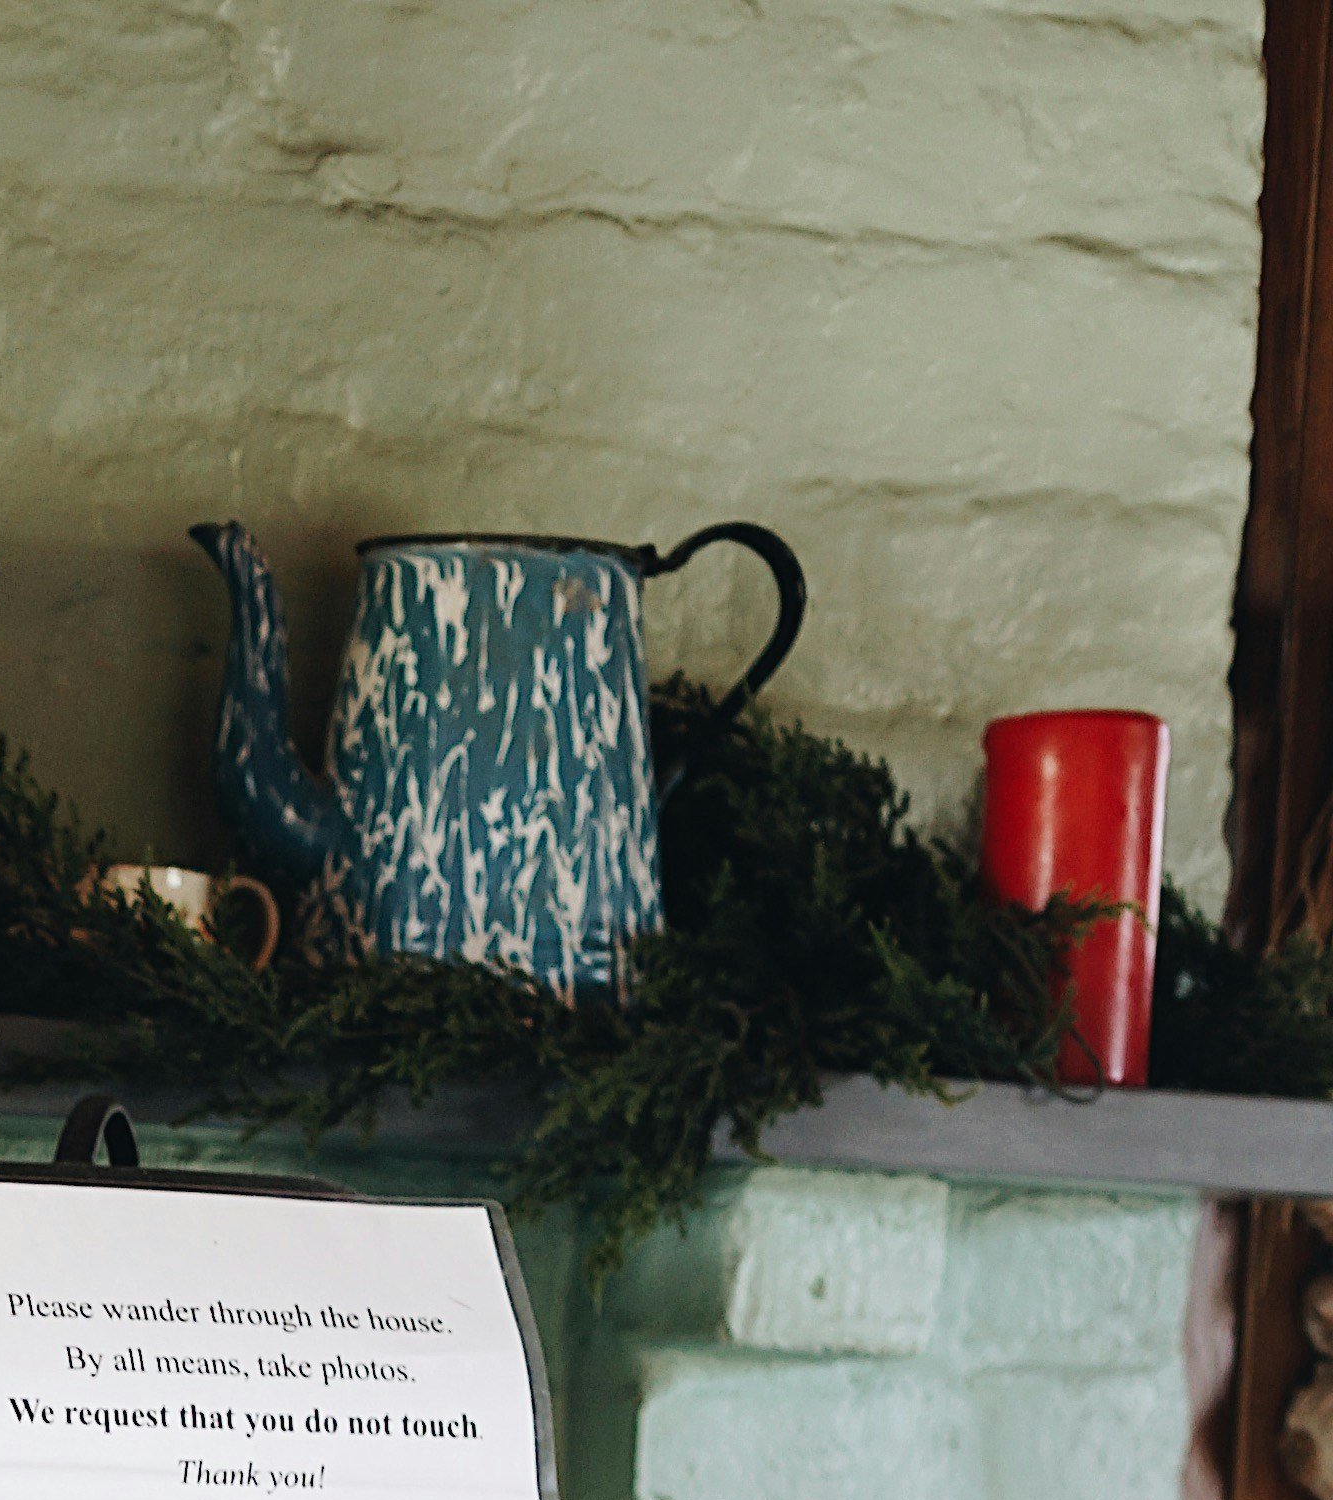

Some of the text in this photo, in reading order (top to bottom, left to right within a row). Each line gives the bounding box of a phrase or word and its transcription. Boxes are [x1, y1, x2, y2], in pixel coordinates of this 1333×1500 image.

[7, 1293, 452, 1334] Please wander through the house.
[65, 1346, 416, 1386] By all means, take photos.
[9, 1397, 483, 1440] We request that you do not touch.
[179, 1459, 325, 1494] Thank you!
